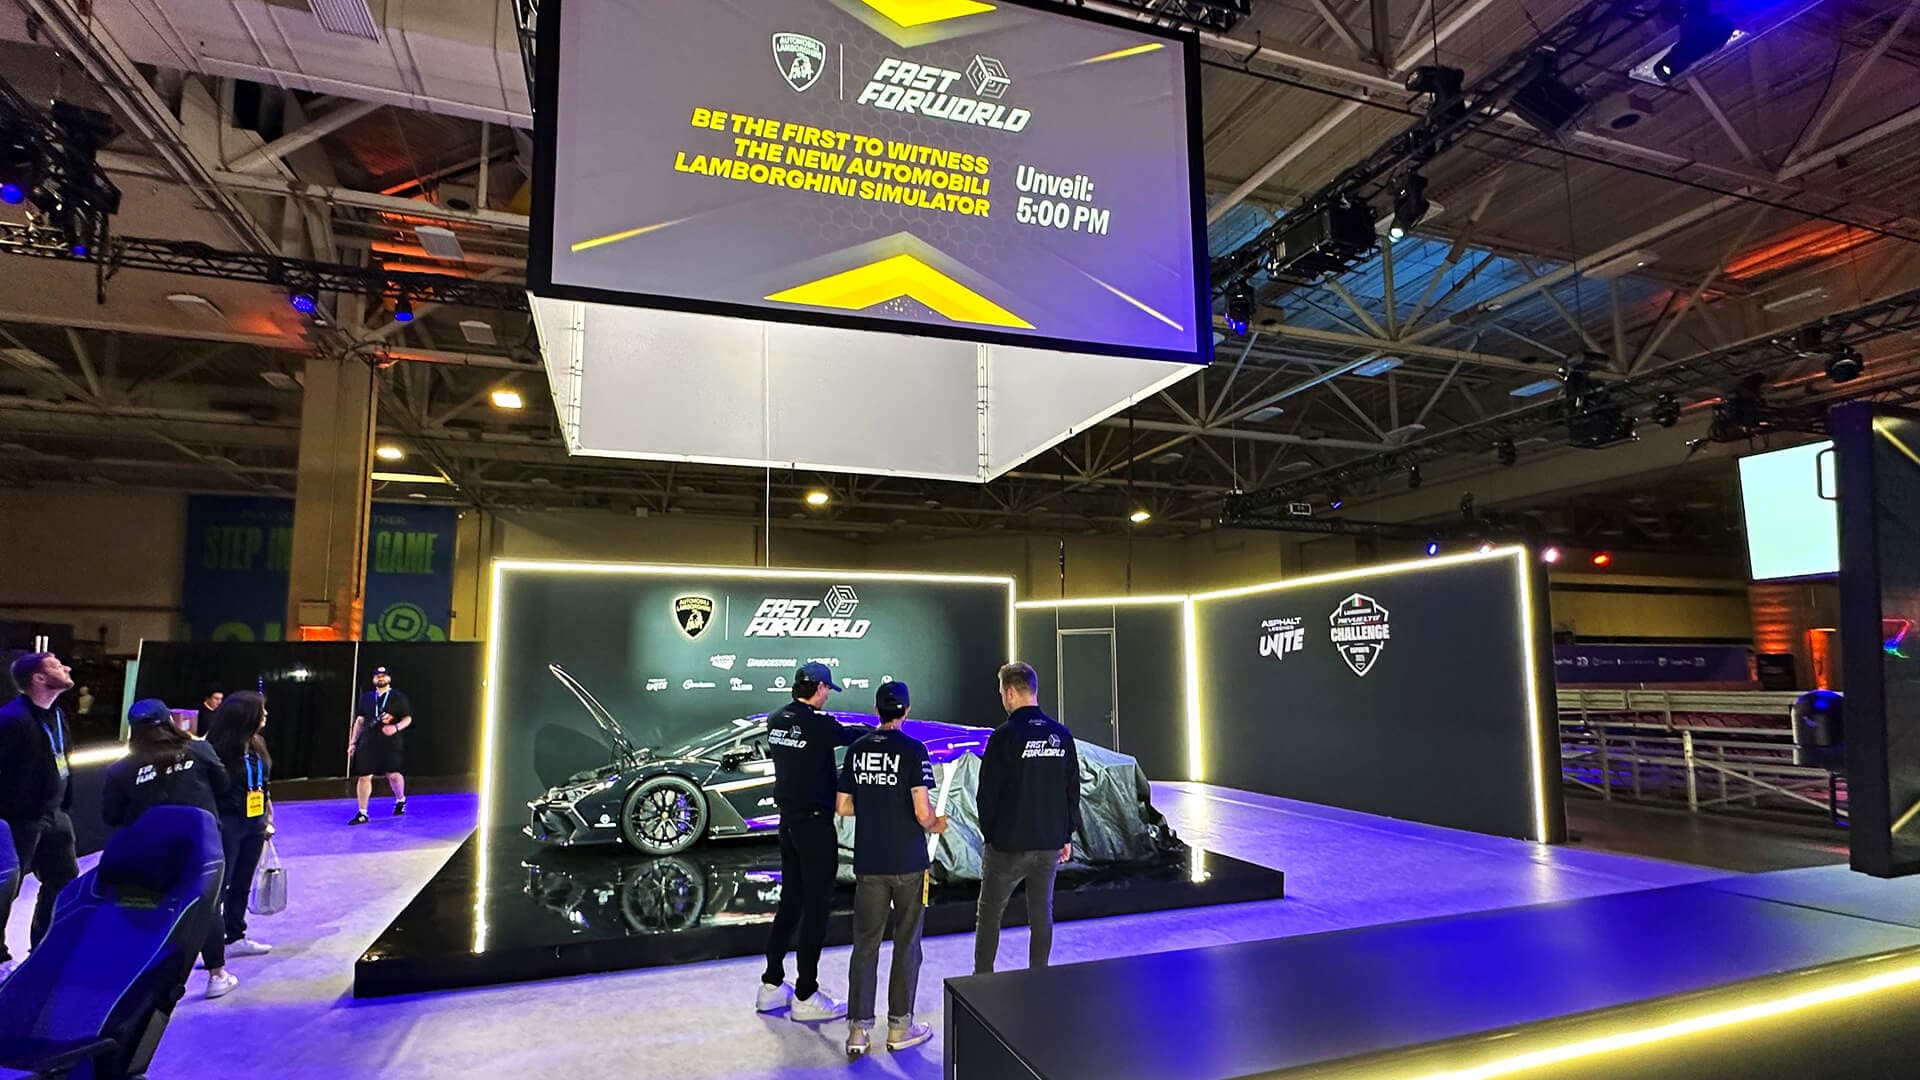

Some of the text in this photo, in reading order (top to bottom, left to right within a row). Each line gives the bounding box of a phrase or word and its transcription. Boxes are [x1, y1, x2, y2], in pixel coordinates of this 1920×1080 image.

[776, 43, 822, 60] LAMBORGHINI
[779, 35, 820, 51] AUTOMOBILI
[873, 57, 962, 93] FAST
[857, 81, 1031, 133] FORWORLD
[691, 107, 990, 174] BE THE FIRST TO WITNESS
[734, 138, 991, 196] THE NEW AUTOMOBILI
[1016, 165, 1094, 202] Unveil:
[674, 152, 991, 217] LAMBORGHINI SIMULATOR
[1016, 196, 1110, 235] 5:00 PM
[375, 530, 439, 575] GAME
[754, 598, 821, 618] FAST
[1261, 617, 1302, 628] ASPHALT
[744, 617, 871, 638] FORWORLD
[1259, 628, 1305, 661] UNITE
[1330, 624, 1390, 642] CHALLENGE
[1025, 740, 1048, 749] FAST
